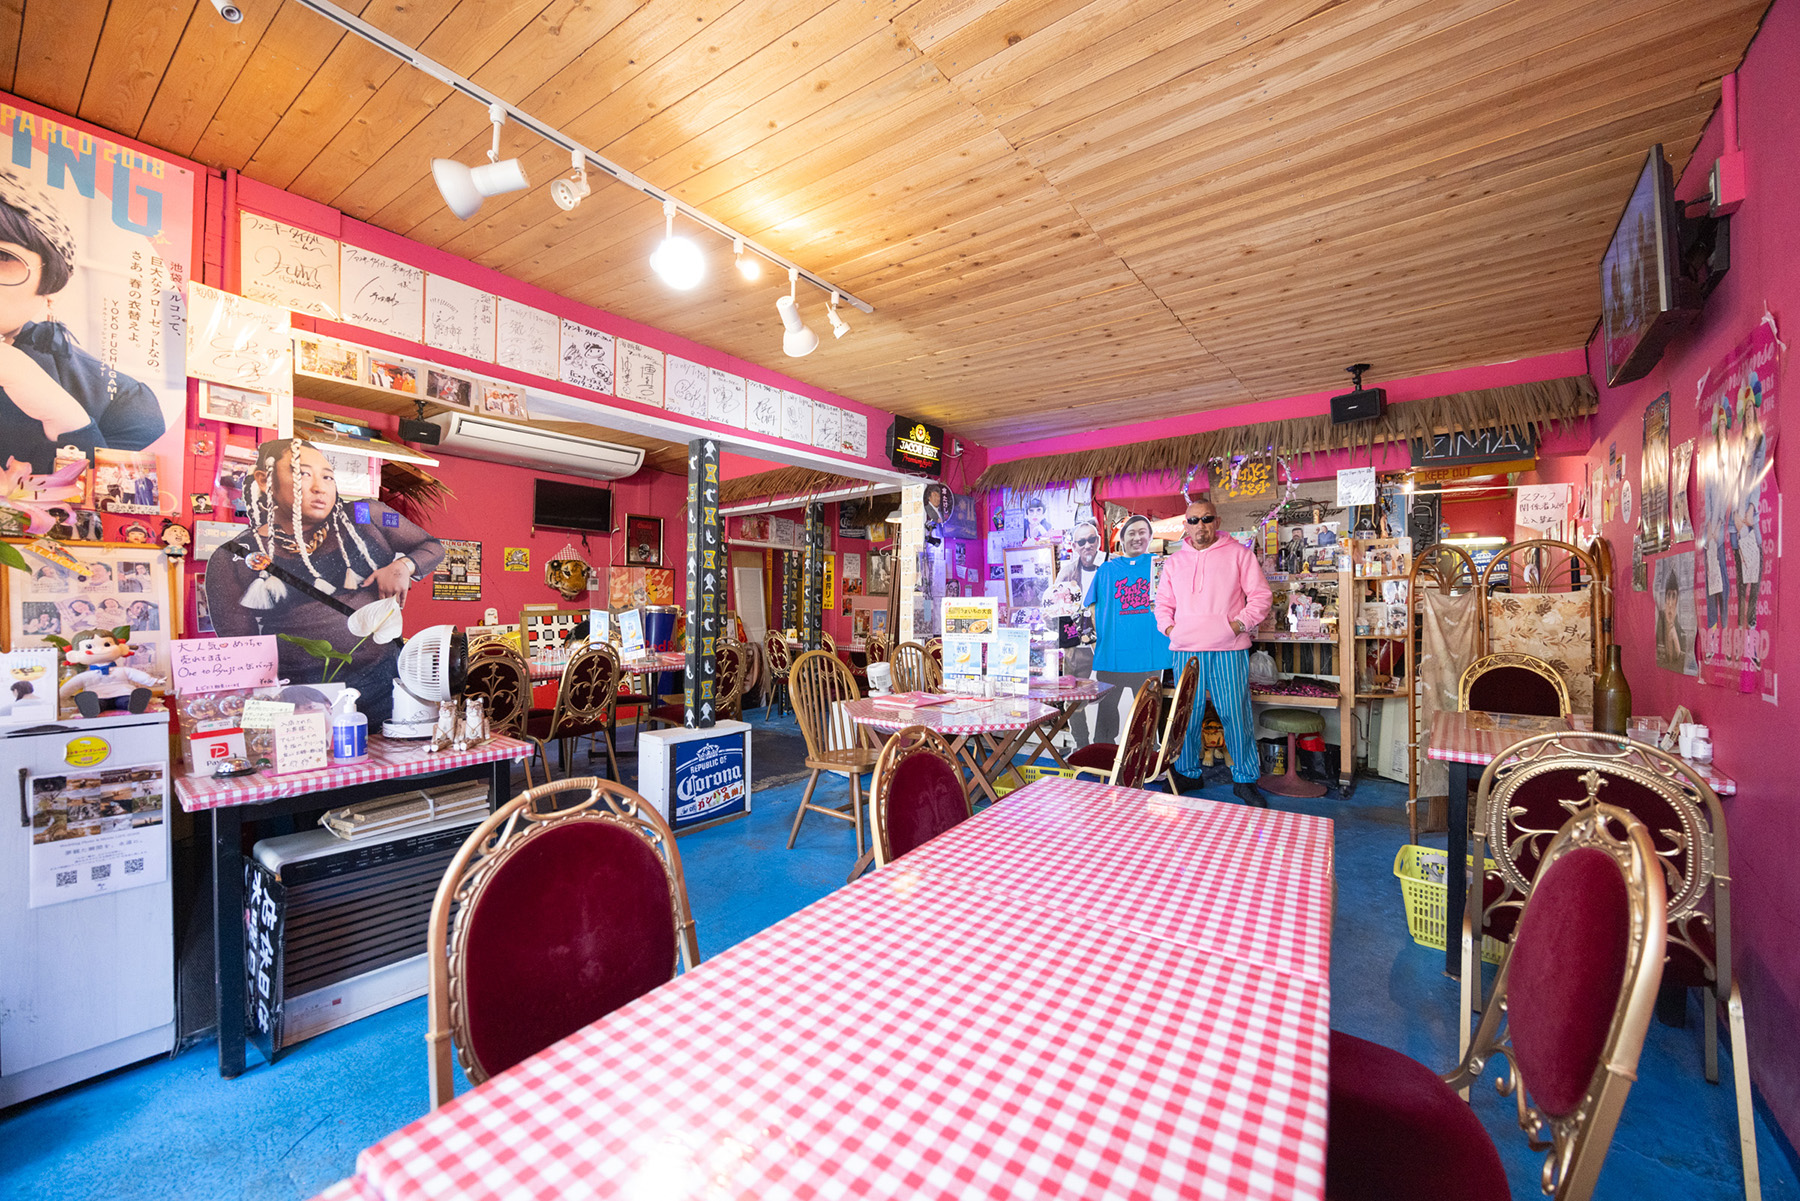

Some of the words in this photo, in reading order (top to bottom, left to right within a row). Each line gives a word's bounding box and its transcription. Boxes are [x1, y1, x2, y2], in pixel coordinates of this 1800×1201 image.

[0, 103, 92, 155] PARCO
[103, 140, 164, 180] 2018
[128, 251, 143, 348] さあ、春の衣替えよ。
[109, 300, 119, 330] YOKO
[147, 256, 164, 373] 巨大なクローゼットなの。
[107, 333, 118, 401] FUCHIGAMI
[900, 440, 922, 454] JACOB
[922, 445, 938, 458] BEST
[1421, 430, 1521, 459] ZIMA
[1424, 469, 1449, 480] KEEP
[1452, 467, 1472, 478] OUT
[177, 641, 220, 653] 大人気
[178, 667, 197, 678] One
[690, 758, 718, 774] REPUBLIC
[719, 755, 728, 765] OF
[677, 765, 742, 801] Corona
